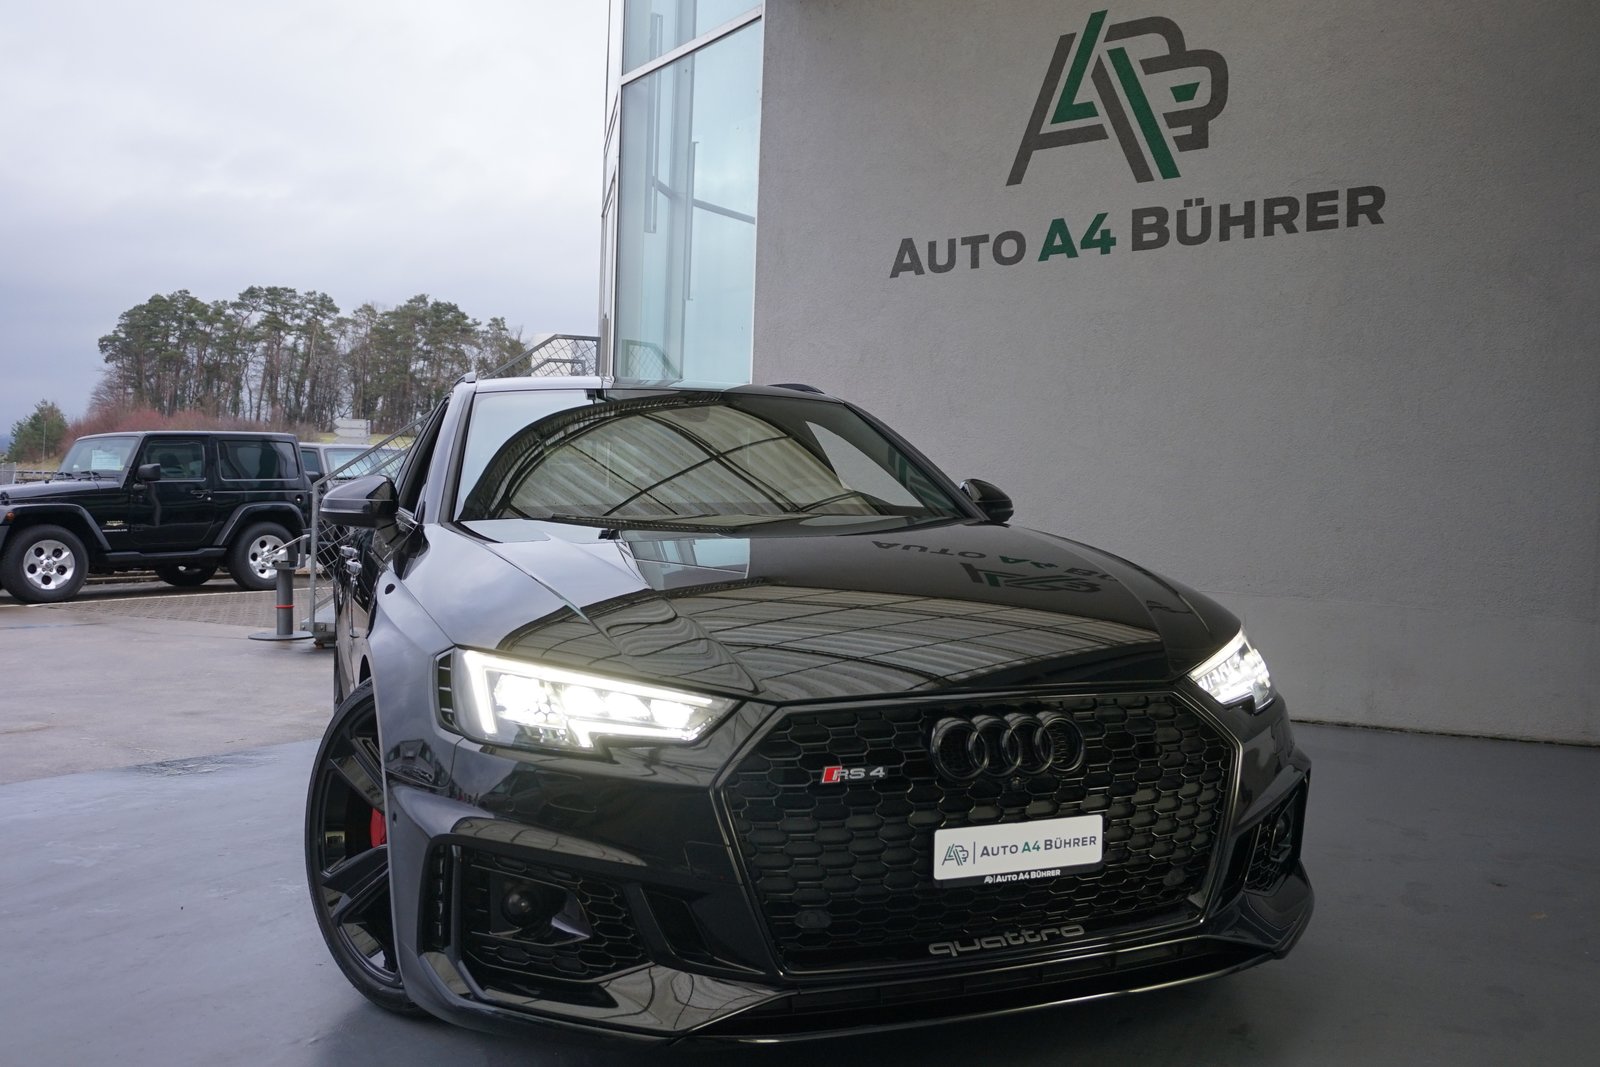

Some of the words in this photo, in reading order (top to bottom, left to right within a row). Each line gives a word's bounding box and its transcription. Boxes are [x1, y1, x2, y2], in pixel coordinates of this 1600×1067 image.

[889, 231, 1027, 278] AUTO
[1038, 212, 1117, 262] A4
[1131, 185, 1386, 252] BÜHRER
[980, 845, 1018, 857] AUTO
[1021, 840, 1041, 853] A4
[1044, 835, 1097, 851] BÜHRER
[995, 874, 1017, 883] AUTO
[1018, 871, 1030, 880] A4
[928, 924, 1085, 957] quattro
